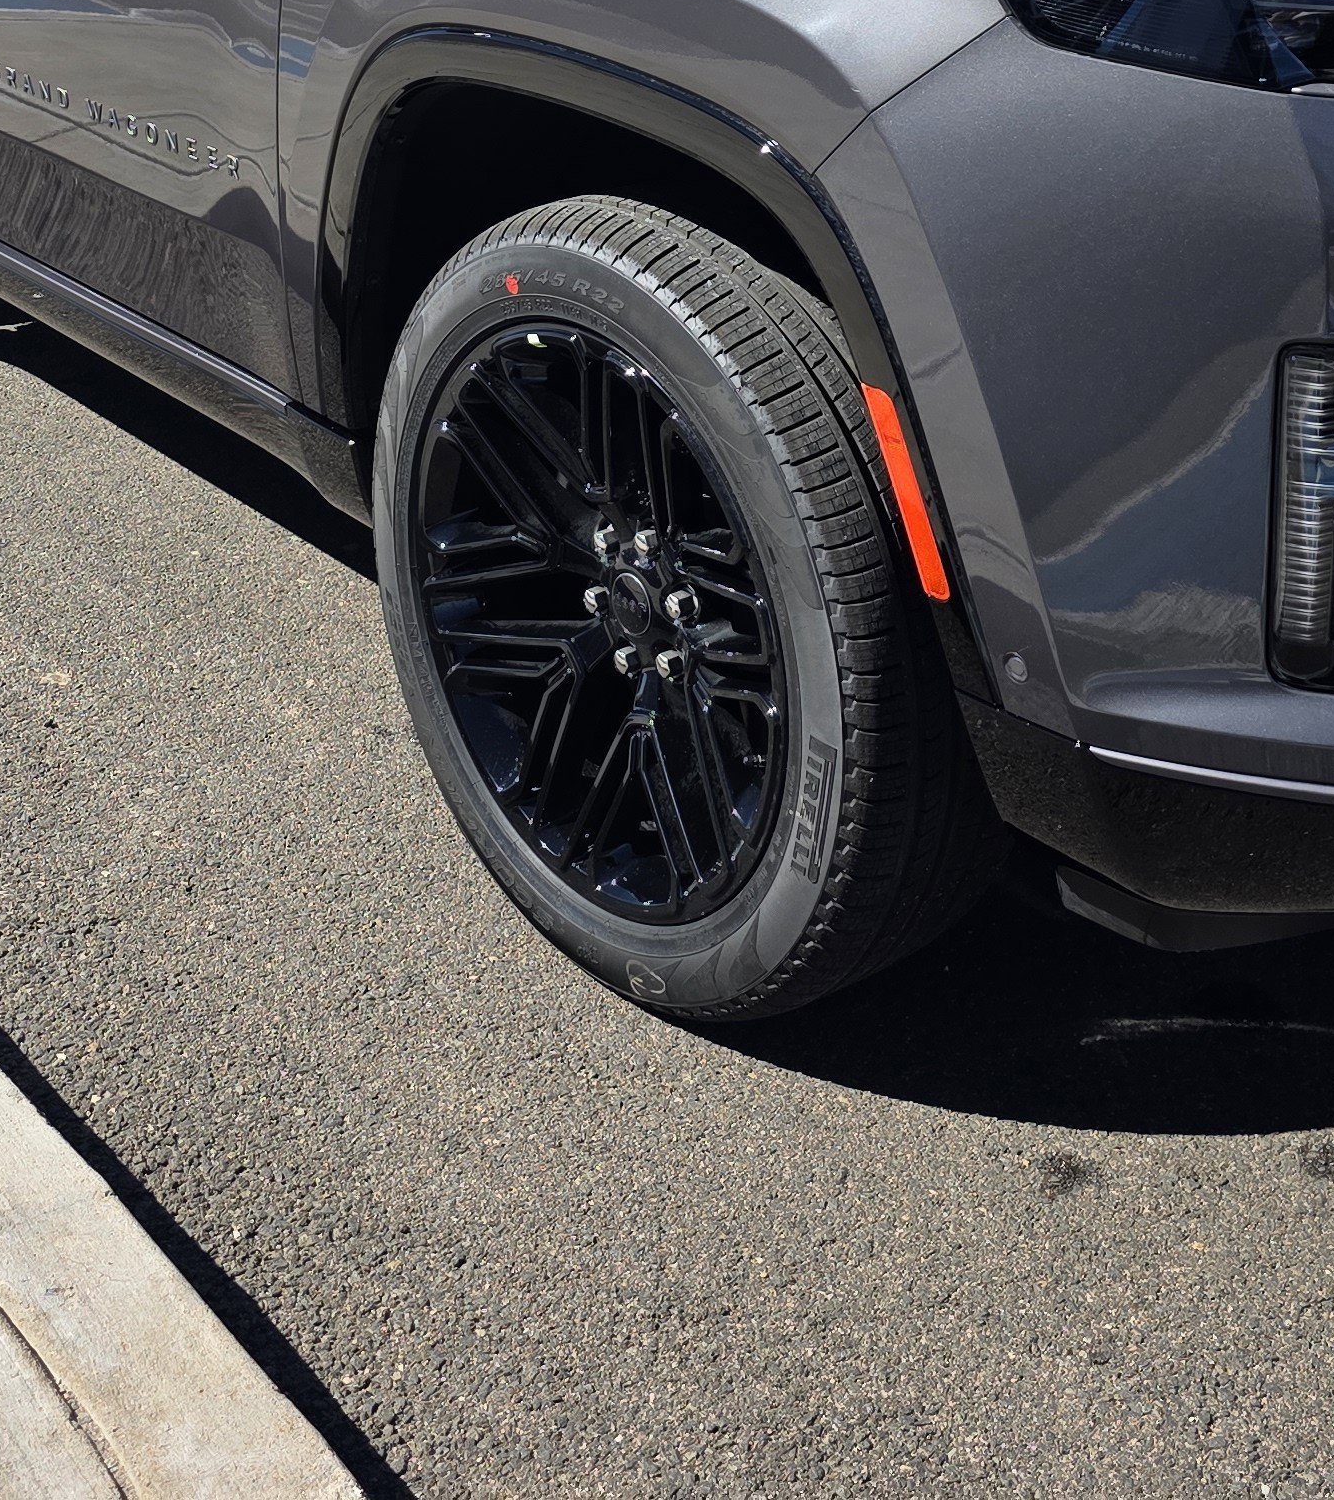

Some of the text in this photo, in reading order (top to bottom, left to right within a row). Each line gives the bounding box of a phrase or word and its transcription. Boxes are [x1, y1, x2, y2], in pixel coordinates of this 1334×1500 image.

[84, 97, 240, 181] WAGONEER
[571, 278, 627, 314] R22
[789, 734, 838, 884] PIRELLI
